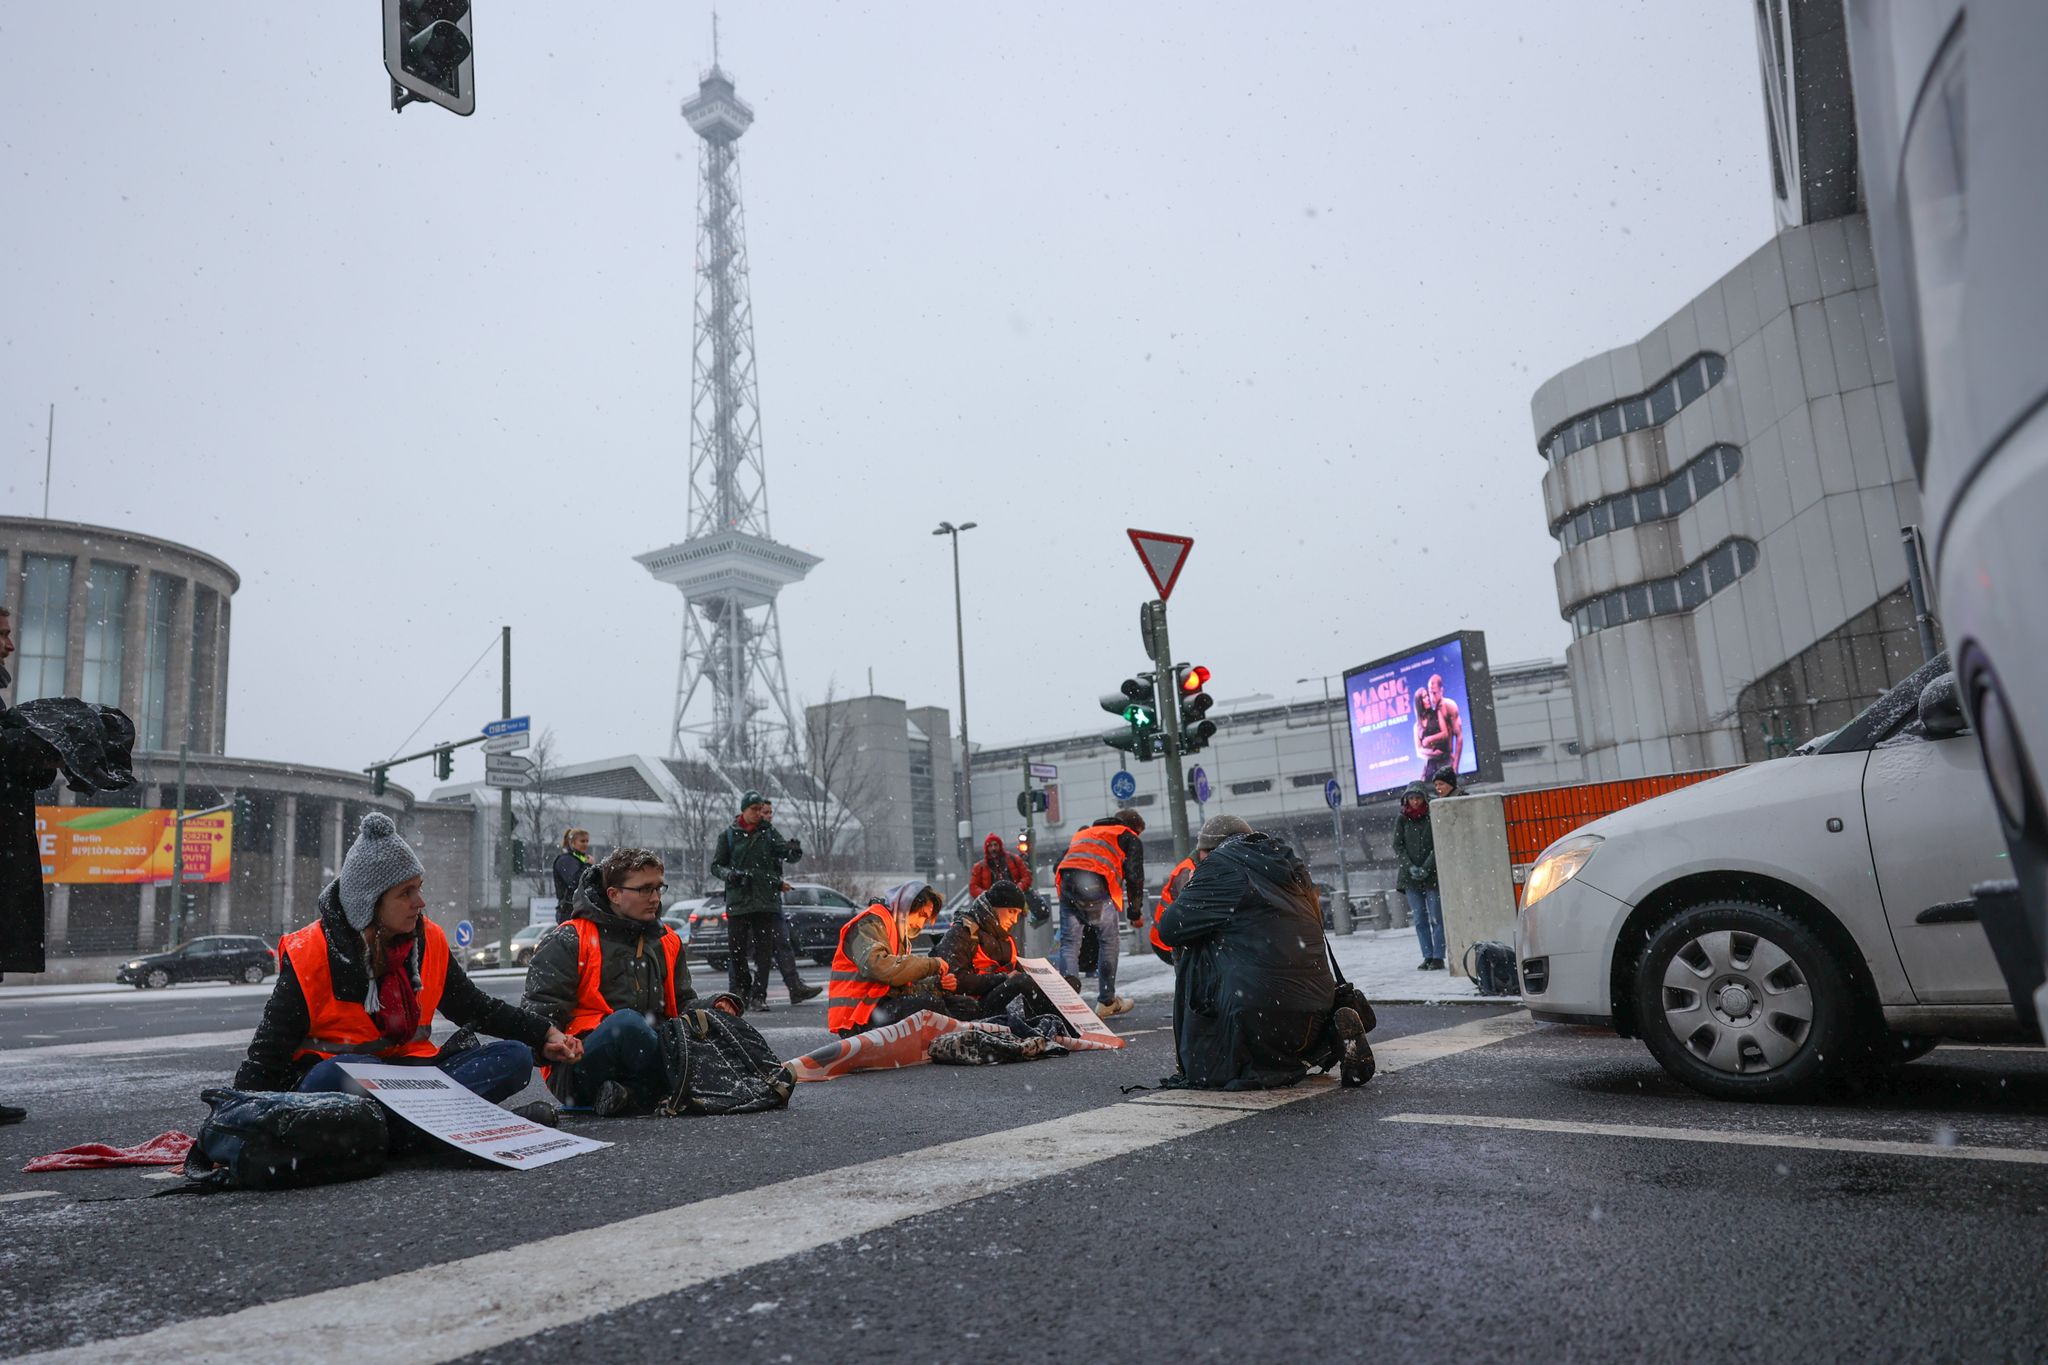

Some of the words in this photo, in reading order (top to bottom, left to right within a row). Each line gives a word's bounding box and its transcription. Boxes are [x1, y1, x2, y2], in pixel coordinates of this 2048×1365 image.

[1353, 677, 1408, 707] MAGIC
[1355, 693, 1411, 728] MIKE
[72, 834, 102, 842] Berlin
[104, 846, 121, 856] Feb
[123, 846, 147, 856] 2023
[182, 854, 207, 862] OUTH
[372, 1079, 450, 1089] ERINNERUNG
